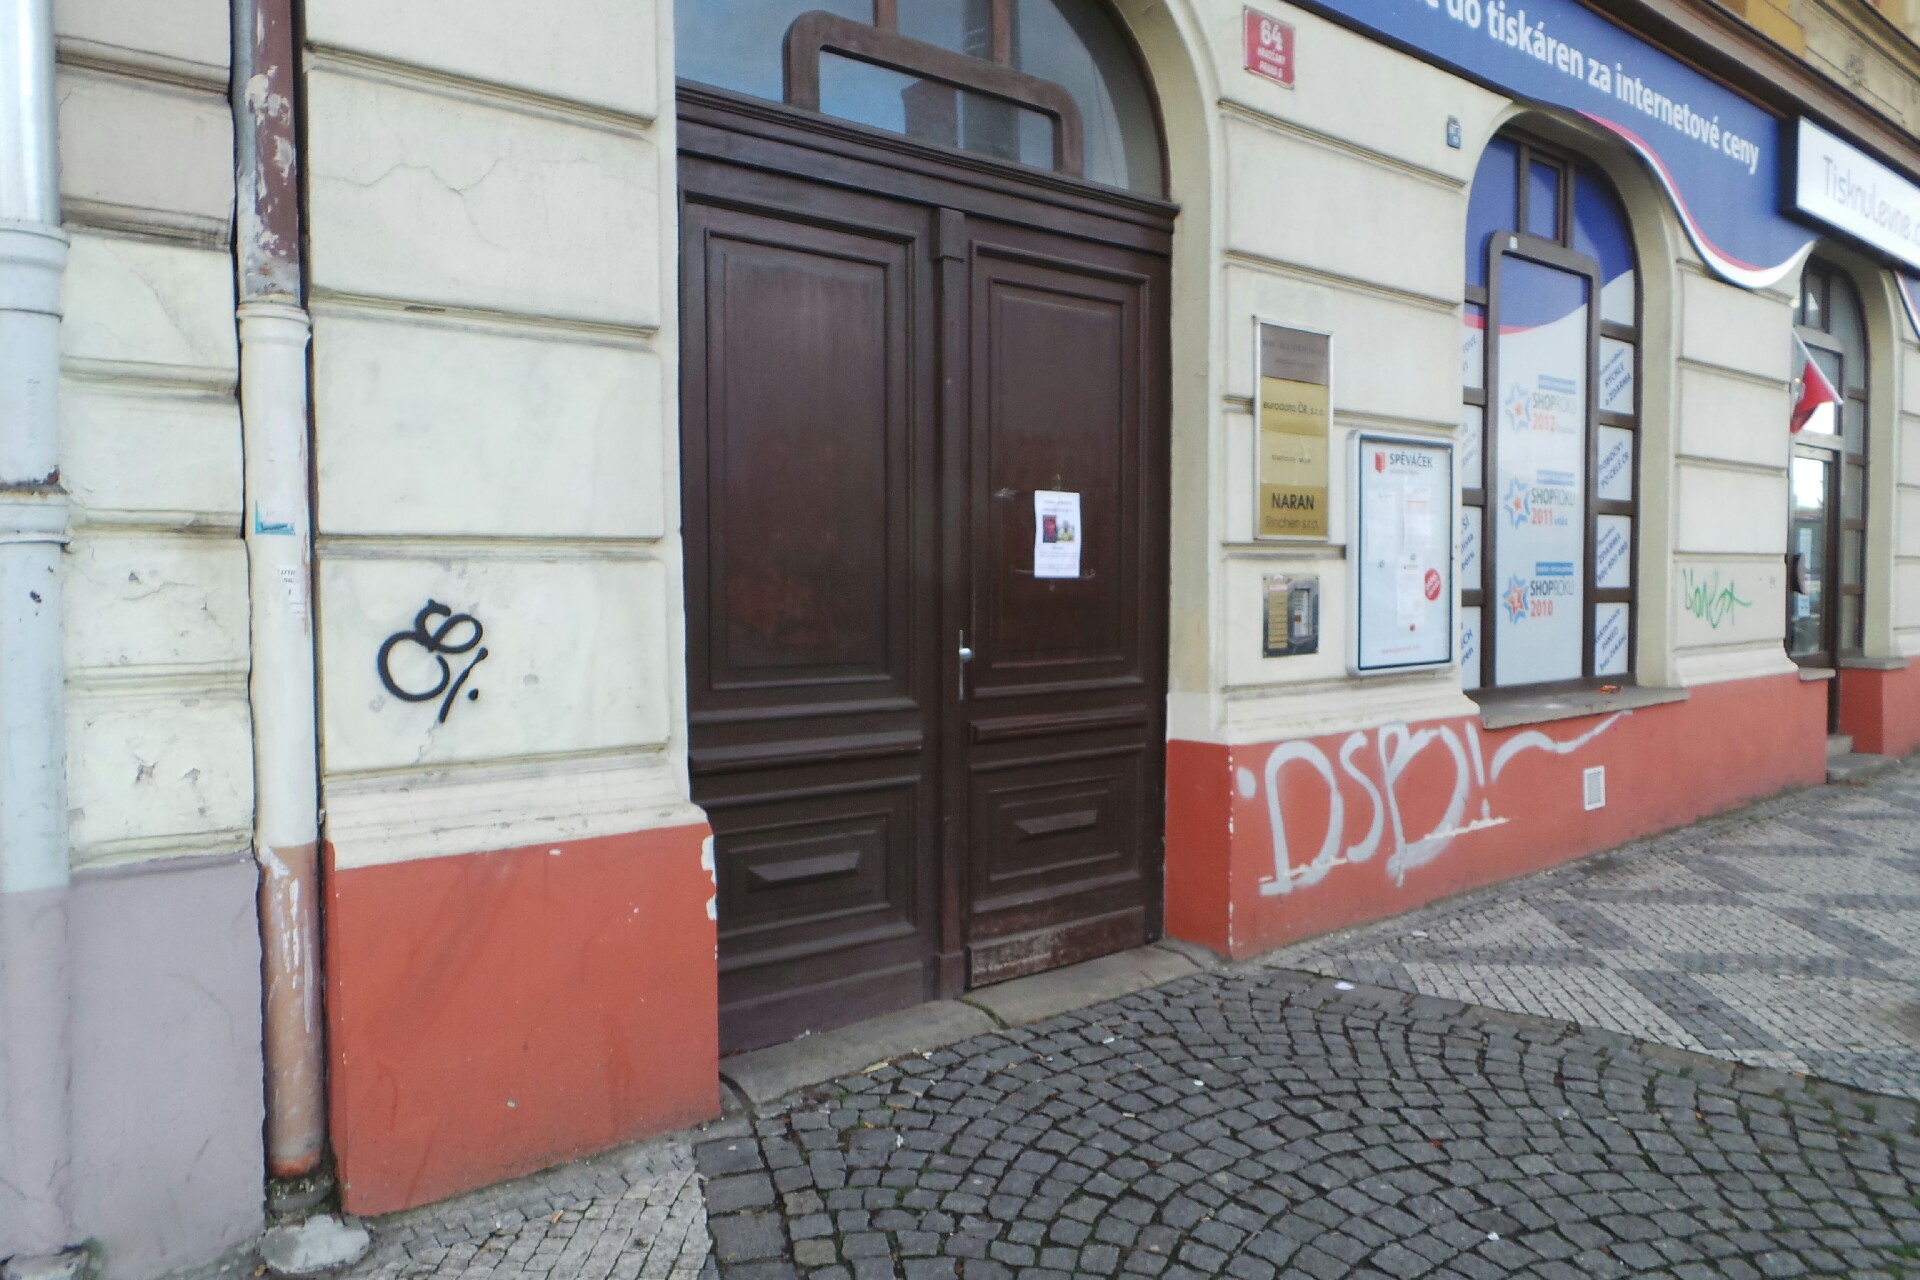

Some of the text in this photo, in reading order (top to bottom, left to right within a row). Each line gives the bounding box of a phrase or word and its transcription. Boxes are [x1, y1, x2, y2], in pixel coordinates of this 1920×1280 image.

[1260, 18, 1284, 51] 64
[1486, 0, 1584, 79] tiskáren
[1588, 58, 1612, 94] za
[1615, 63, 1720, 149] internetové
[1722, 131, 1760, 174] ceny
[1532, 412, 1556, 432] 2012
[1389, 451, 1434, 468] SPĚVÁČEK
[1272, 492, 1315, 510] NARAN
[1531, 507, 1554, 526] 2011
[1530, 579, 1576, 596] SHOPROKU
[1530, 599, 1553, 617] 2010
